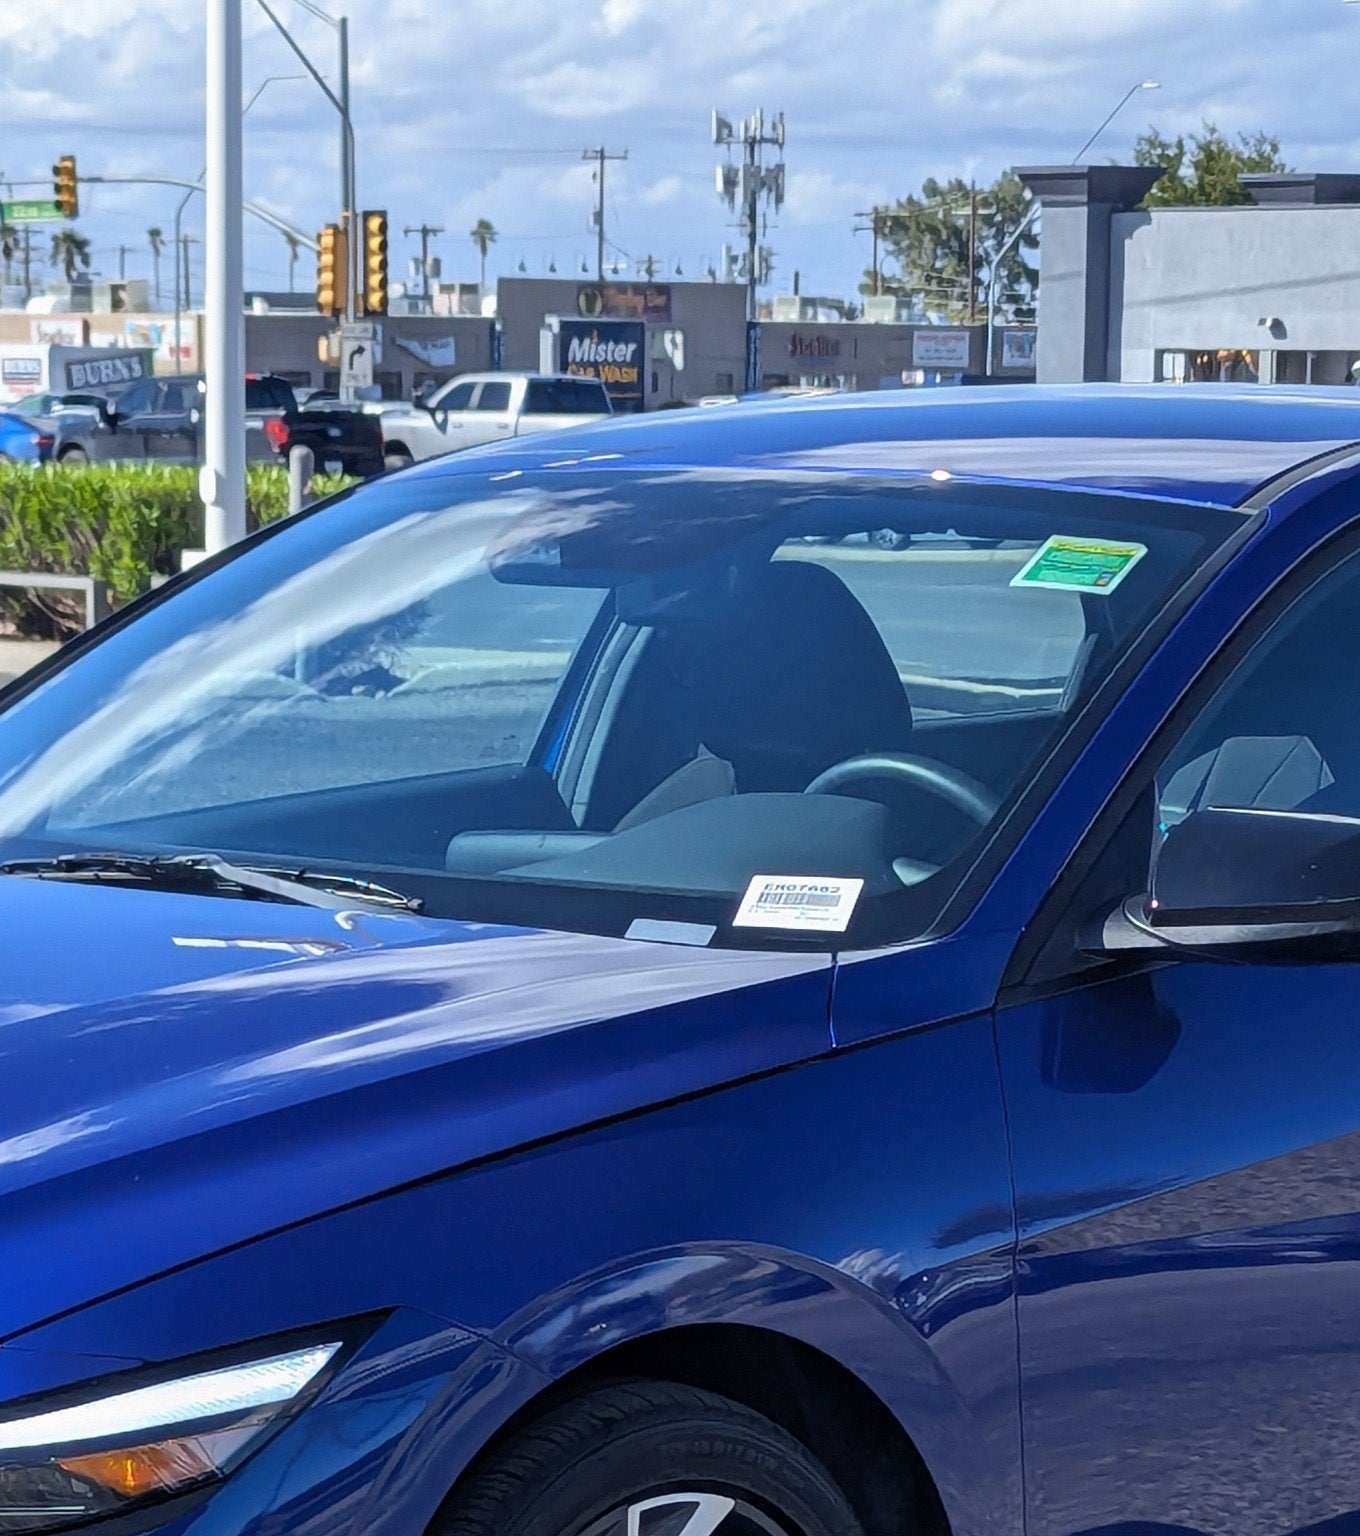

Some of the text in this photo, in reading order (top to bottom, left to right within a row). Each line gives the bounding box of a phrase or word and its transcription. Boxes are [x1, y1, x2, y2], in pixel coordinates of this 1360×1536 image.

[567, 337, 637, 363] Mister
[71, 356, 142, 388] BURNS
[599, 365, 638, 383] WASH
